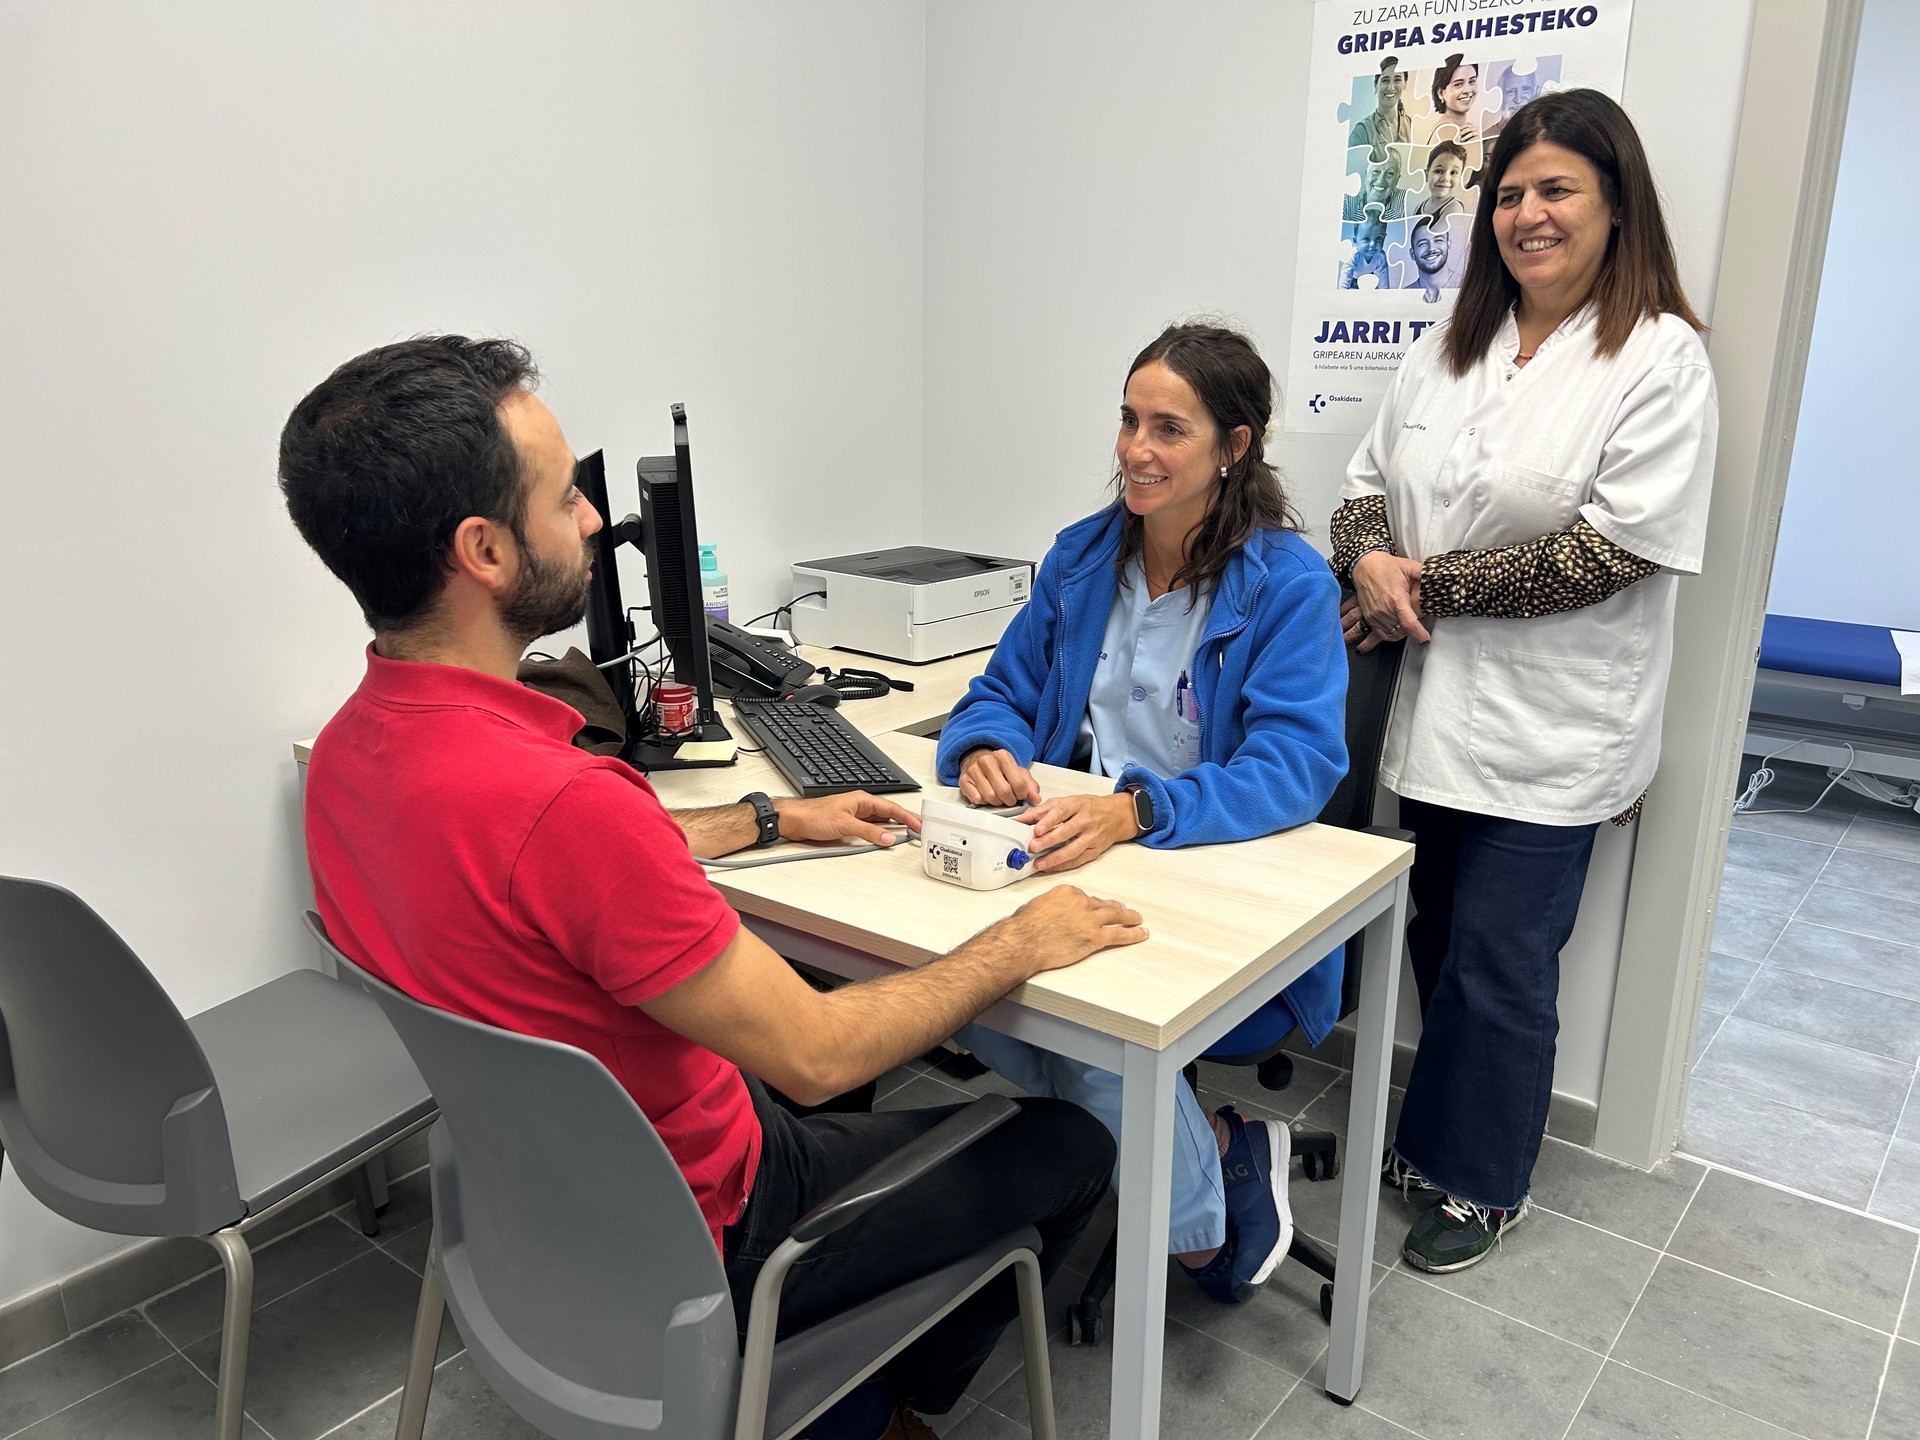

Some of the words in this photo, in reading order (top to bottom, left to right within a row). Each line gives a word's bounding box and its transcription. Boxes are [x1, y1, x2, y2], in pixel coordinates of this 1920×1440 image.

[1353, 10, 1373, 26] ZU
[1377, 4, 1420, 24] ZARA
[1424, 0, 1524, 16] FUNTSEZ
[1337, 26, 1425, 55] GRIPEA
[1430, 5, 1598, 44] SAIHESTEKO
[1313, 320, 1401, 344] JARRI
[1312, 350, 1363, 360] GRIPEAREN
[973, 588, 990, 598] EPSON
